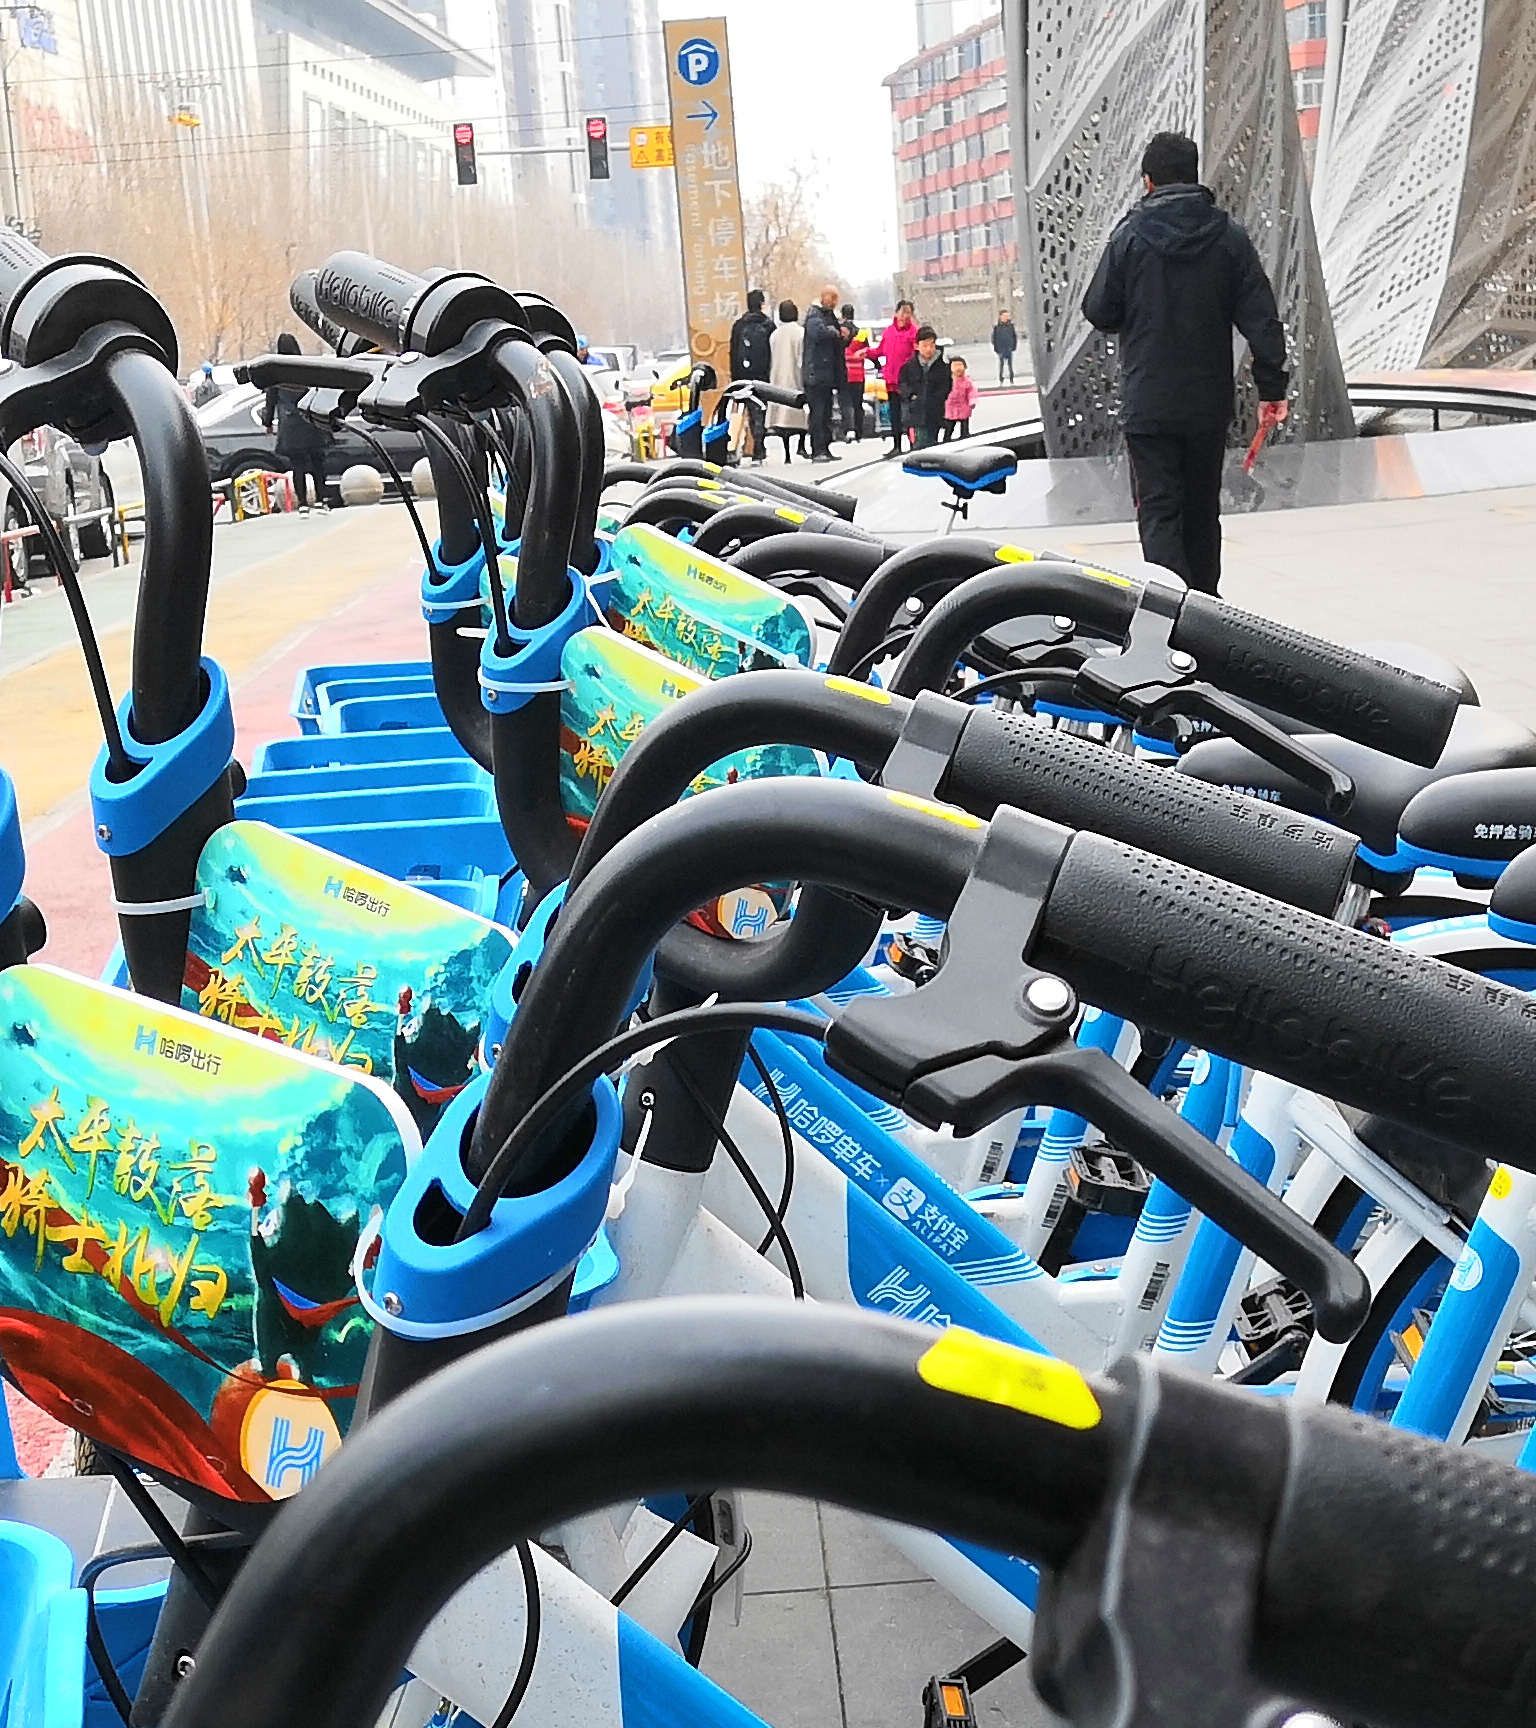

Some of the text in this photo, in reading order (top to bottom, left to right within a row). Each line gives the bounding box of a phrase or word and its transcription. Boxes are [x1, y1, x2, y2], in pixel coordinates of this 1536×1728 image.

[701, 138, 740, 322] 地下停车场
[343, 886, 391, 918] 哈啰出行
[159, 1036, 223, 1076] 哈啰出行
[785, 1098, 883, 1183] 哈啰单车
[917, 1201, 970, 1251] 支付宝
[911, 1220, 957, 1259] ALIPAY
